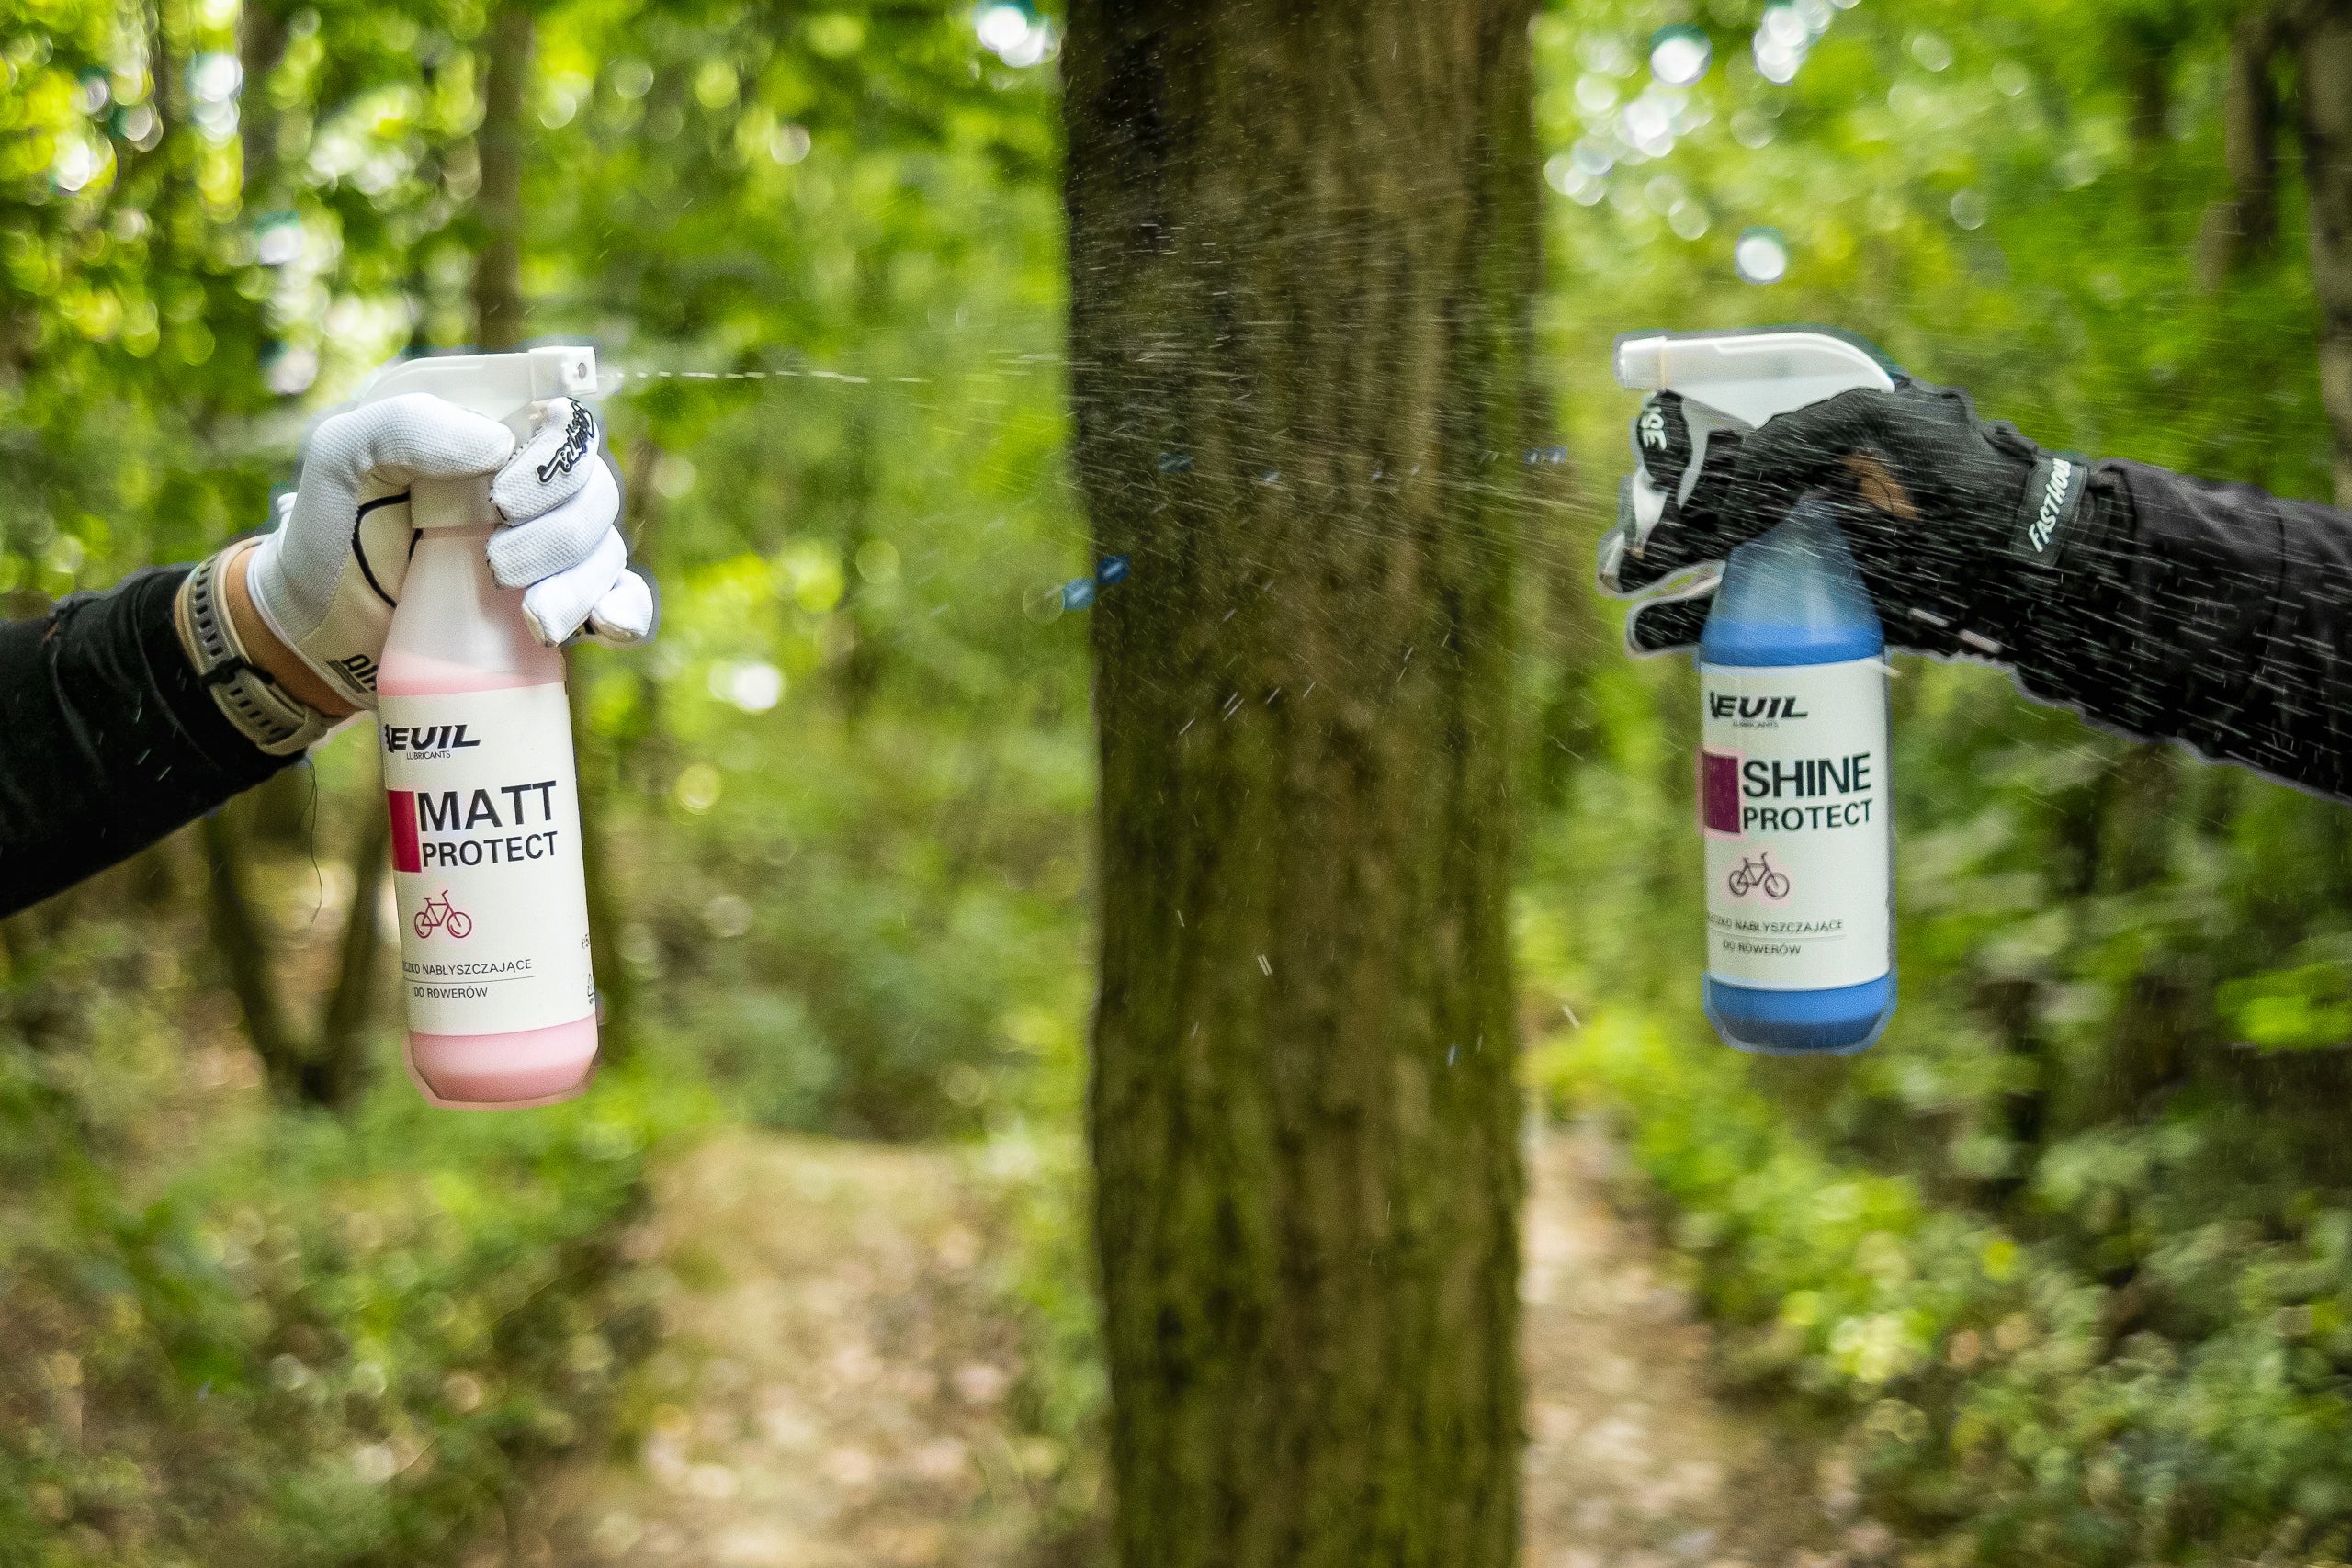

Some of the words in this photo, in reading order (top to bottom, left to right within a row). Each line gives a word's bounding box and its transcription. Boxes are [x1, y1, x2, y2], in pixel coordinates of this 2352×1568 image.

[1733, 720, 1780, 729] LUBRICANTS
[406, 750, 451, 761] LUBRICANTS
[1742, 751, 1871, 798] SHINE
[417, 781, 557, 832] MATT
[1743, 798, 1873, 831] PROTECT
[421, 831, 558, 868] PROTECT
[1723, 940, 1736, 951] DO
[1738, 941, 1801, 955] ROWERÓW
[423, 959, 532, 976] NABŁYSZCZAJĄCE
[413, 987, 424, 998] DO
[427, 986, 488, 998] ROWERÓW
